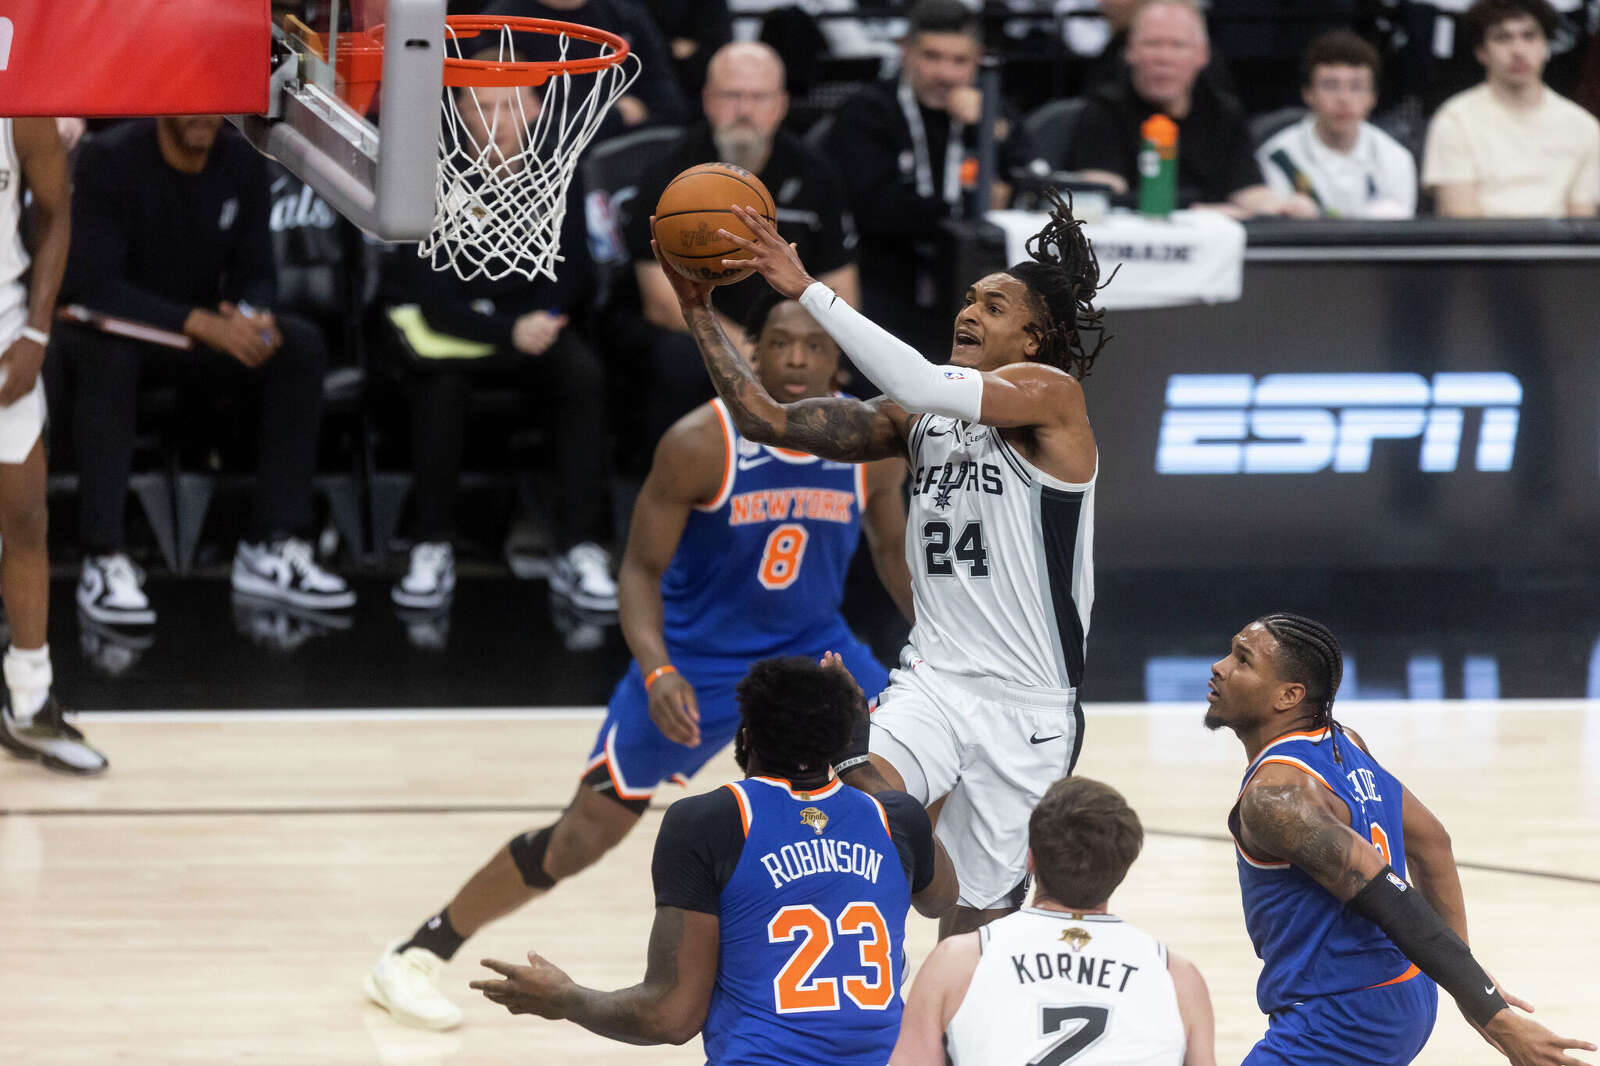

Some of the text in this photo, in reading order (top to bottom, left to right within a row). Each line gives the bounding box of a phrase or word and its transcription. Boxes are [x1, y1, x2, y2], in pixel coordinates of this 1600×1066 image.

[269, 183, 336, 232] als
[1155, 372, 1524, 474] ESPN
[728, 486, 855, 526] NEW YORK
[757, 523, 809, 590] 8
[921, 519, 992, 579] 24
[800, 810, 828, 824] Finals
[760, 838, 884, 889] ROBINSON
[767, 901, 895, 1014] 23
[1011, 953, 1139, 992] KORNET
